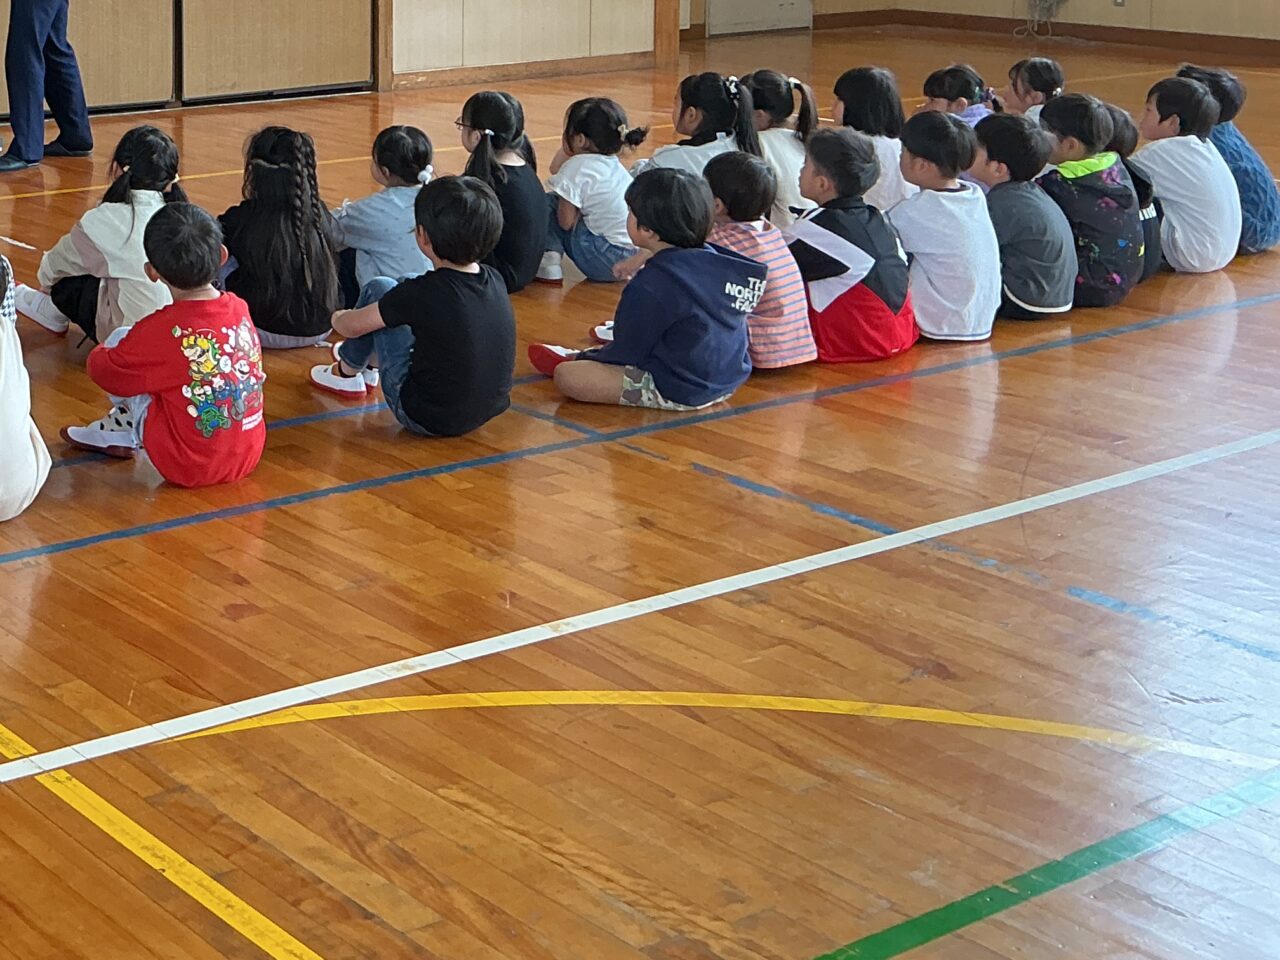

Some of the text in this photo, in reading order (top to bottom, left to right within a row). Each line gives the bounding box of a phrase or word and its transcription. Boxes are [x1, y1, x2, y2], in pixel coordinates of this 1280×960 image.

[725, 282, 764, 303] NORT
[748, 276, 767, 294] TH
[736, 298, 757, 312] FAC
